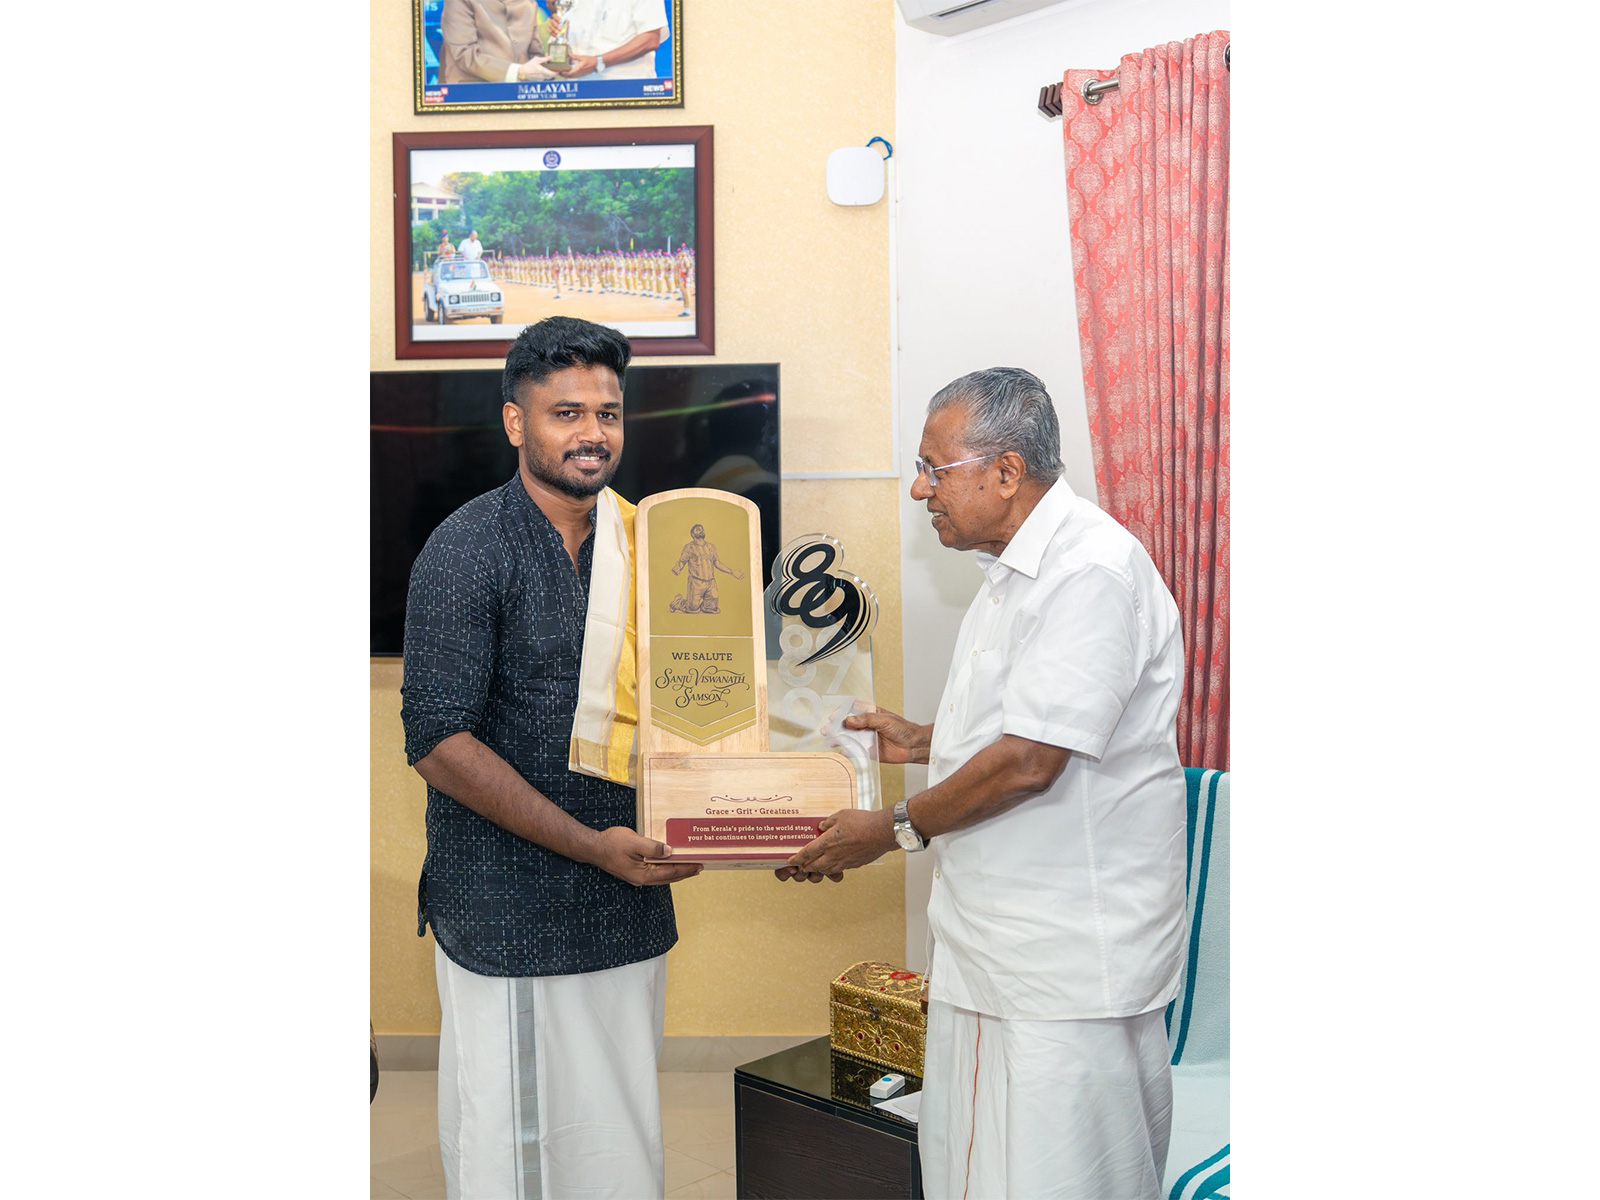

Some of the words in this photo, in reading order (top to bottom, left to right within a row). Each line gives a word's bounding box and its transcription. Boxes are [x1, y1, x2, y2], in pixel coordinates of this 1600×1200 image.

[518, 83, 578, 94] MALAYALI
[671, 652, 690, 661] WE
[692, 652, 733, 661] SALUTE
[688, 665, 750, 690] VISWANATH
[675, 687, 731, 708] SAMSON
[705, 808, 729, 816] Grace
[736, 807, 753, 816] Grit
[759, 807, 800, 815] Greatness
[738, 825, 755, 833] pride
[795, 825, 814, 833] stage,
